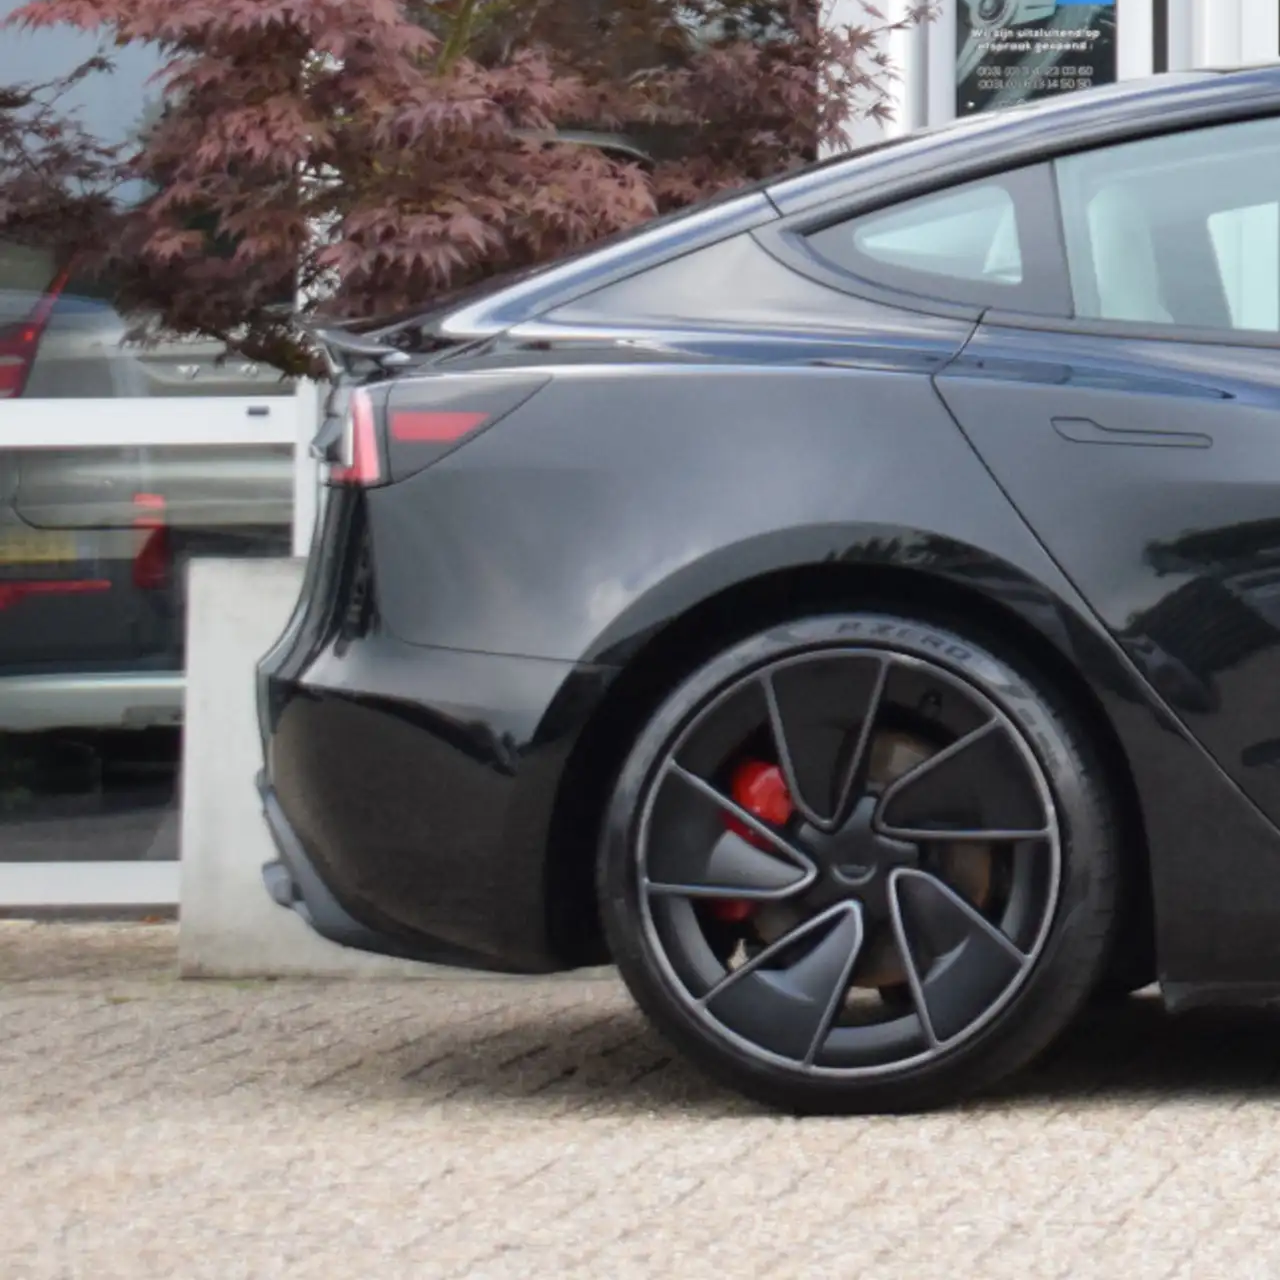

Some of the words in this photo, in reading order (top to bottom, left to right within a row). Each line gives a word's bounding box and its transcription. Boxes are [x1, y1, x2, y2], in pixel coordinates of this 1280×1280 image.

[993, 28, 1013, 40] zijn
[1017, 28, 1081, 38] uitsluitend
[1085, 29, 1100, 40] op
[978, 41, 1031, 53] afspraak
